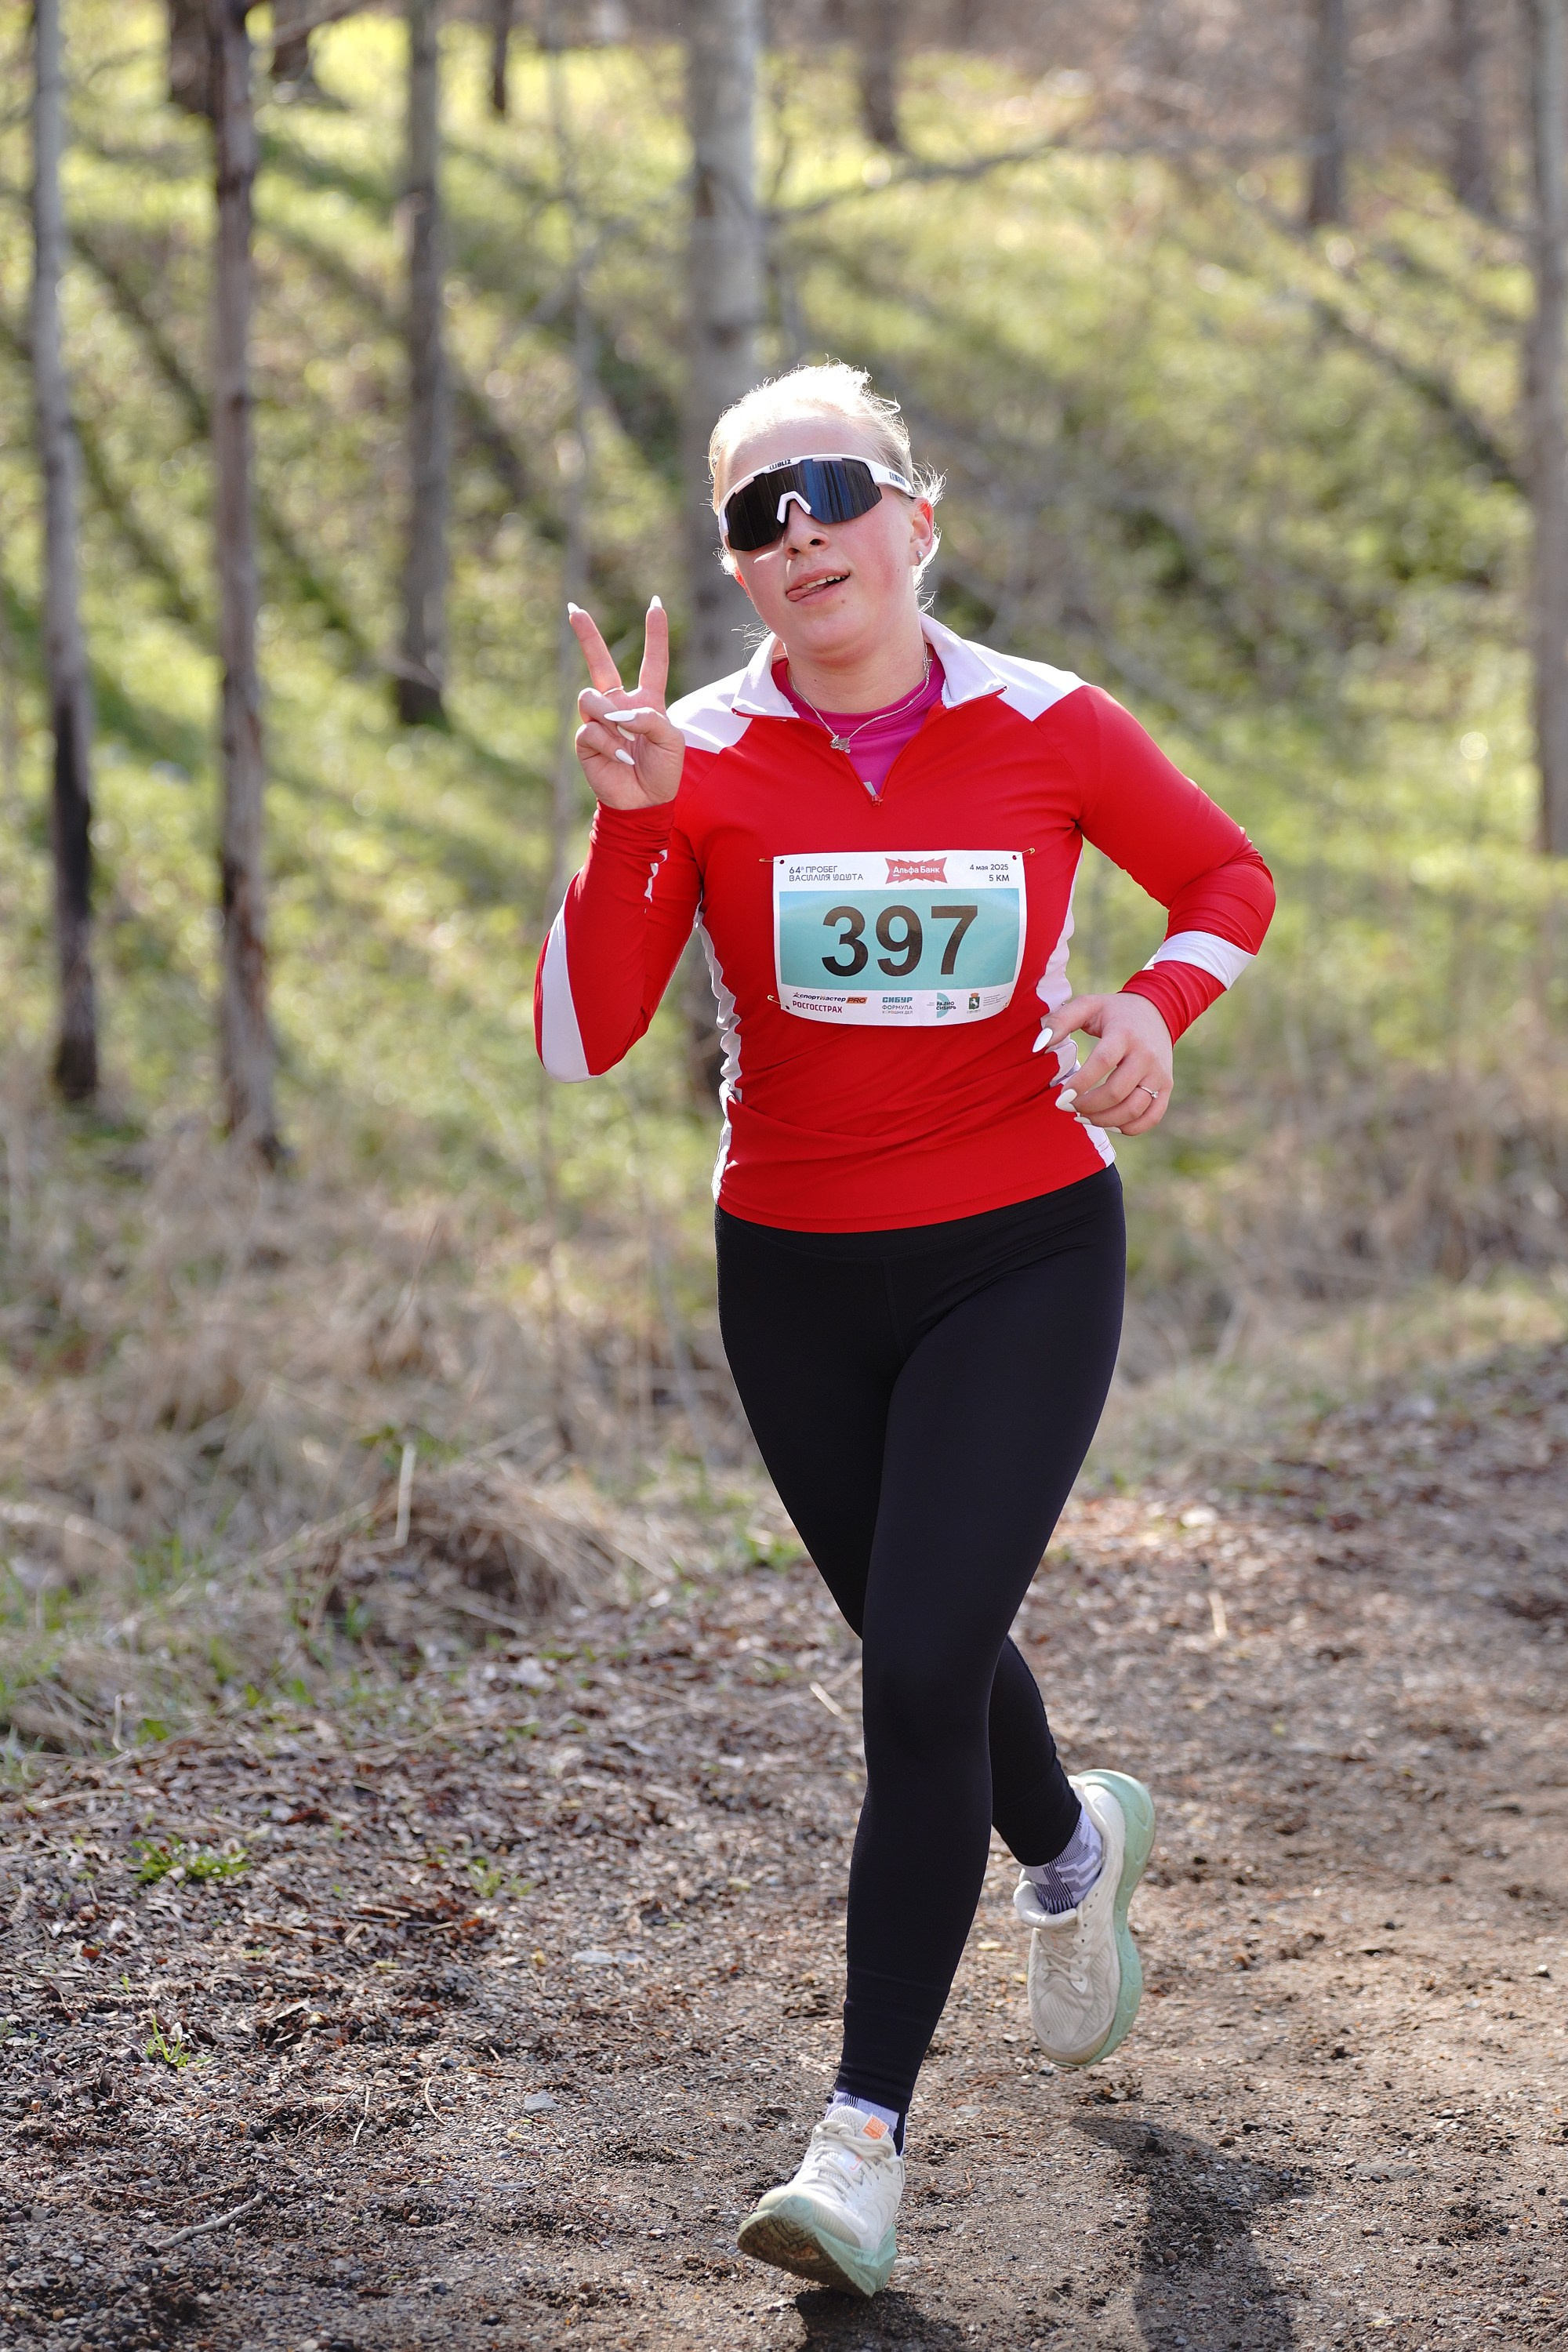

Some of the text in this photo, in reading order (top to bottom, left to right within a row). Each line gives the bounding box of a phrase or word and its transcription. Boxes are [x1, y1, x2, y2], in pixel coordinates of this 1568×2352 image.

[893, 866, 919, 875] Альфа
[822, 905, 978, 977] 397
[792, 1000, 843, 1014] РОСГОССТРАХ
